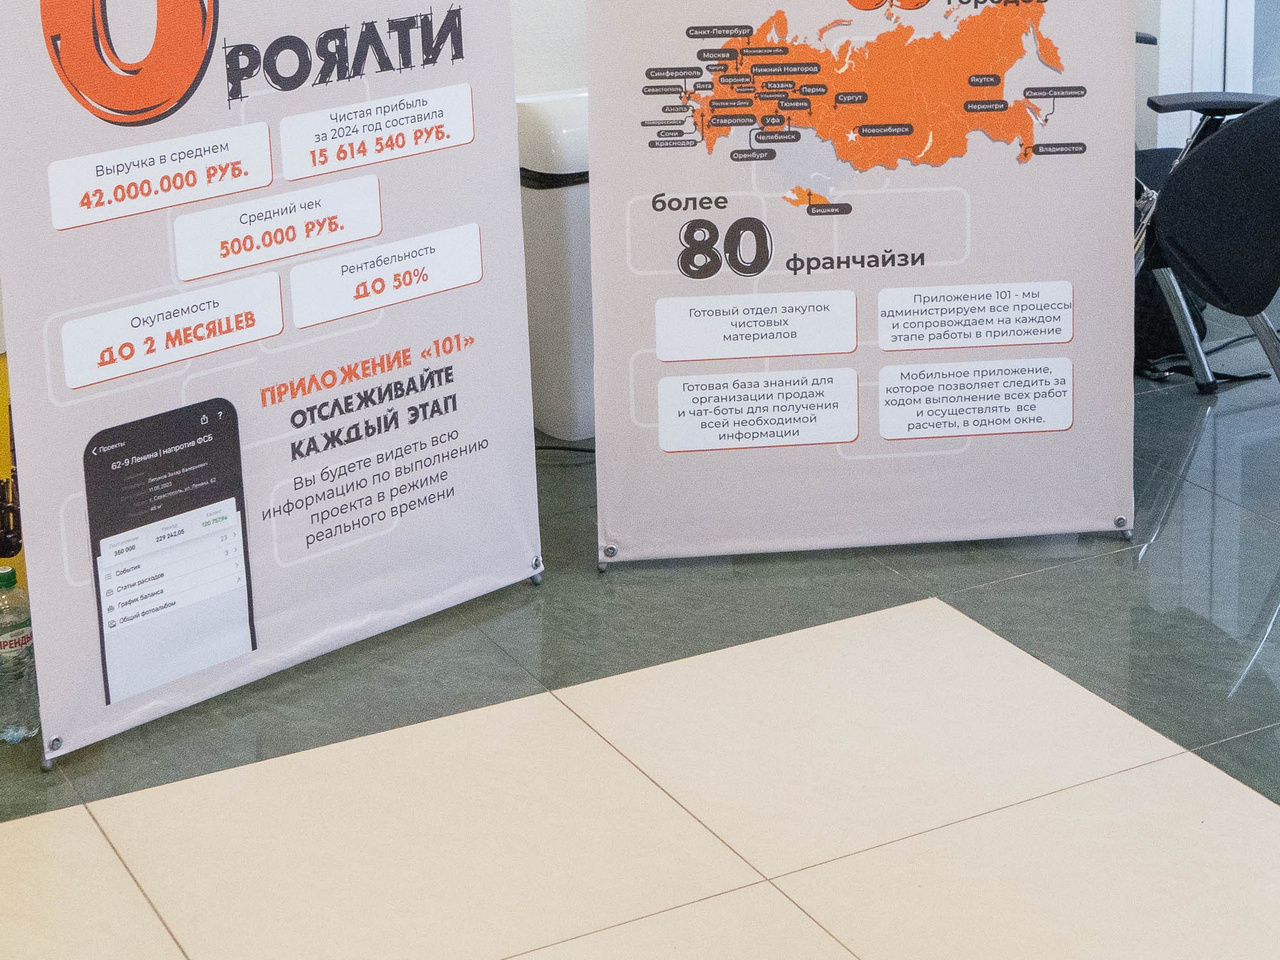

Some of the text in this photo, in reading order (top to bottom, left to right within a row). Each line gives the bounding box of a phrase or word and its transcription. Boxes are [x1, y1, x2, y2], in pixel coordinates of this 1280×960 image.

[689, 28, 750, 36] Санкт-Петербург
[223, 4, 464, 109] РОЯЛТИ
[784, 65, 818, 73] Новгород
[1025, 89, 1085, 97] Южно-Сахалинск
[968, 103, 1004, 111] Нерюнгри
[862, 126, 909, 134] Новосибирск
[309, 123, 451, 167] 15 614 540 РУБ.
[1038, 145, 1083, 153] Владивосток
[94, 142, 229, 178] Выручка в среднем
[79, 160, 249, 210] 42.000.000 РУБ.
[238, 198, 322, 226] Средний чек
[651, 192, 729, 212] более
[219, 214, 345, 259] 500.000 РУБ.
[677, 217, 774, 279] 80
[340, 245, 436, 276] Рентабельность
[785, 248, 925, 276] франчайзи
[352, 266, 429, 300] ДО 50%
[129, 299, 220, 329] Окупаемость
[688, 303, 830, 318] Готовый отдел закупок
[729, 318, 789, 329] чистовых
[96, 310, 256, 368] ДО 2 МЕСЯЦЕВ
[722, 330, 798, 343] материалов
[260, 332, 475, 408] ПРИЛОЖЕНИЕ «101»
[681, 376, 834, 392] Готовая база знаний для
[289, 364, 454, 429] ОТСЛЕЖИВАЙТЕ
[690, 389, 825, 406] организации продаж
[290, 392, 457, 462] КАЖДЫЙ ЭТАП
[699, 413, 817, 429] всей необходимой
[717, 428, 800, 442] информации
[98, 440, 126, 453] Проекты
[110, 457, 130, 471] 62-9
[130, 450, 159, 465] Ленина
[161, 439, 196, 455] напротив
[195, 432, 214, 445] ФСБ
[114, 563, 141, 577] События
[116, 572, 165, 593] Статьи расходов
[117, 588, 164, 608] График баланса
[118, 600, 176, 624] Общий фотоальбом
